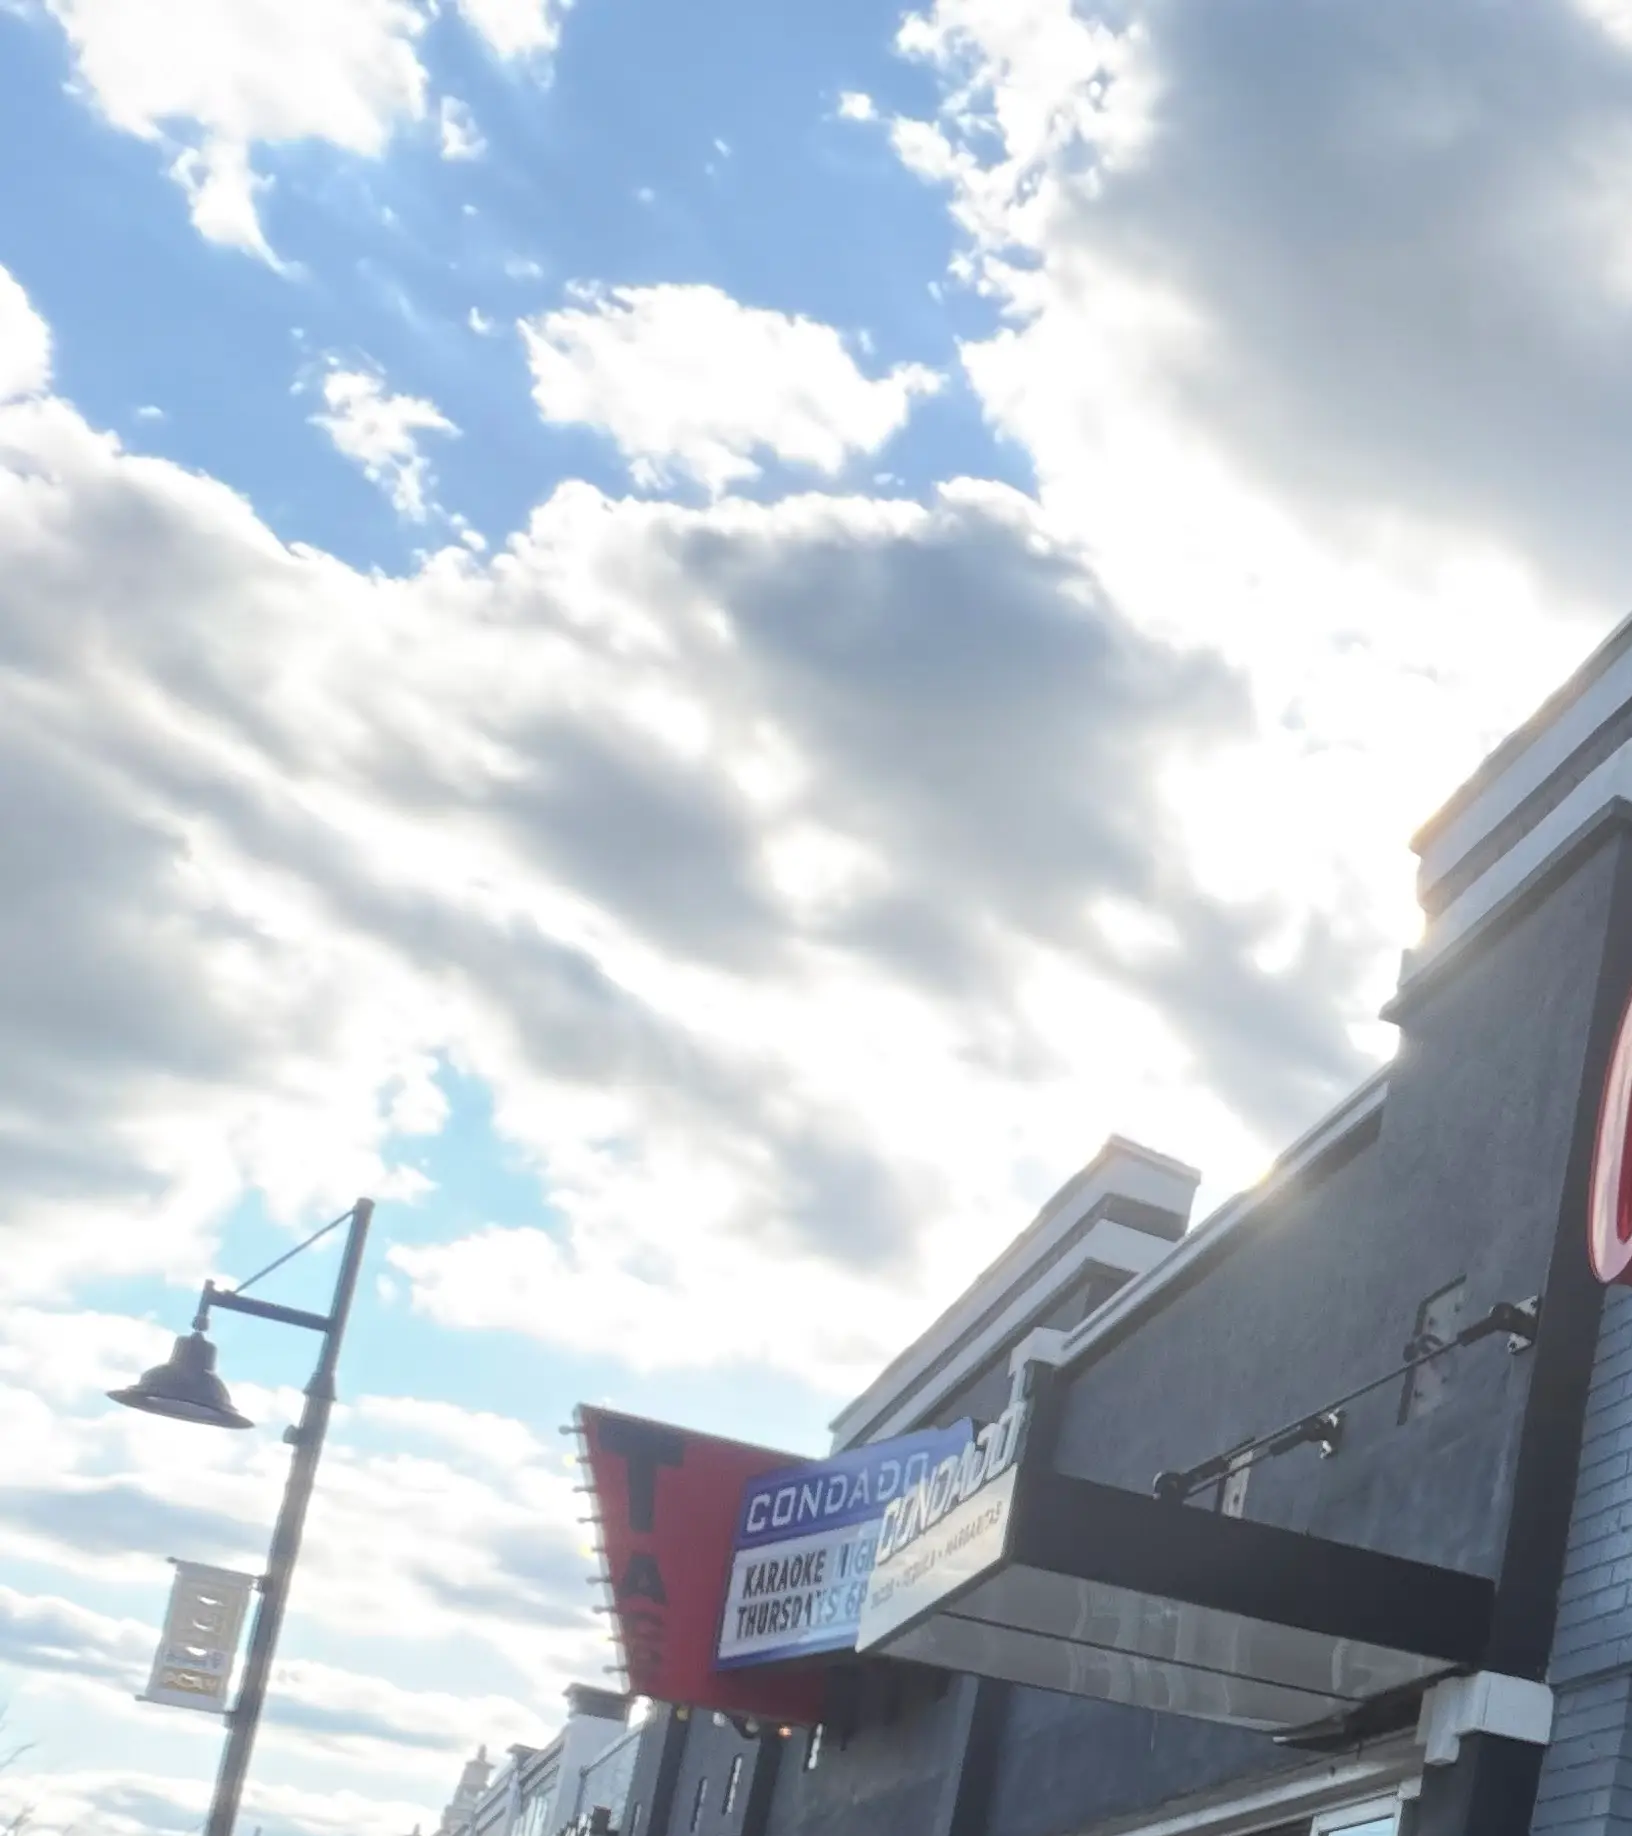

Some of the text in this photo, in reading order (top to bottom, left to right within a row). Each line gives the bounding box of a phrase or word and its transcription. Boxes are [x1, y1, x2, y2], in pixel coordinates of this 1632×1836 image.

[747, 1452, 929, 1533] CONDADO
[742, 1549, 827, 1598] KARAOKE
[736, 1586, 839, 1641] THURSDAYS
